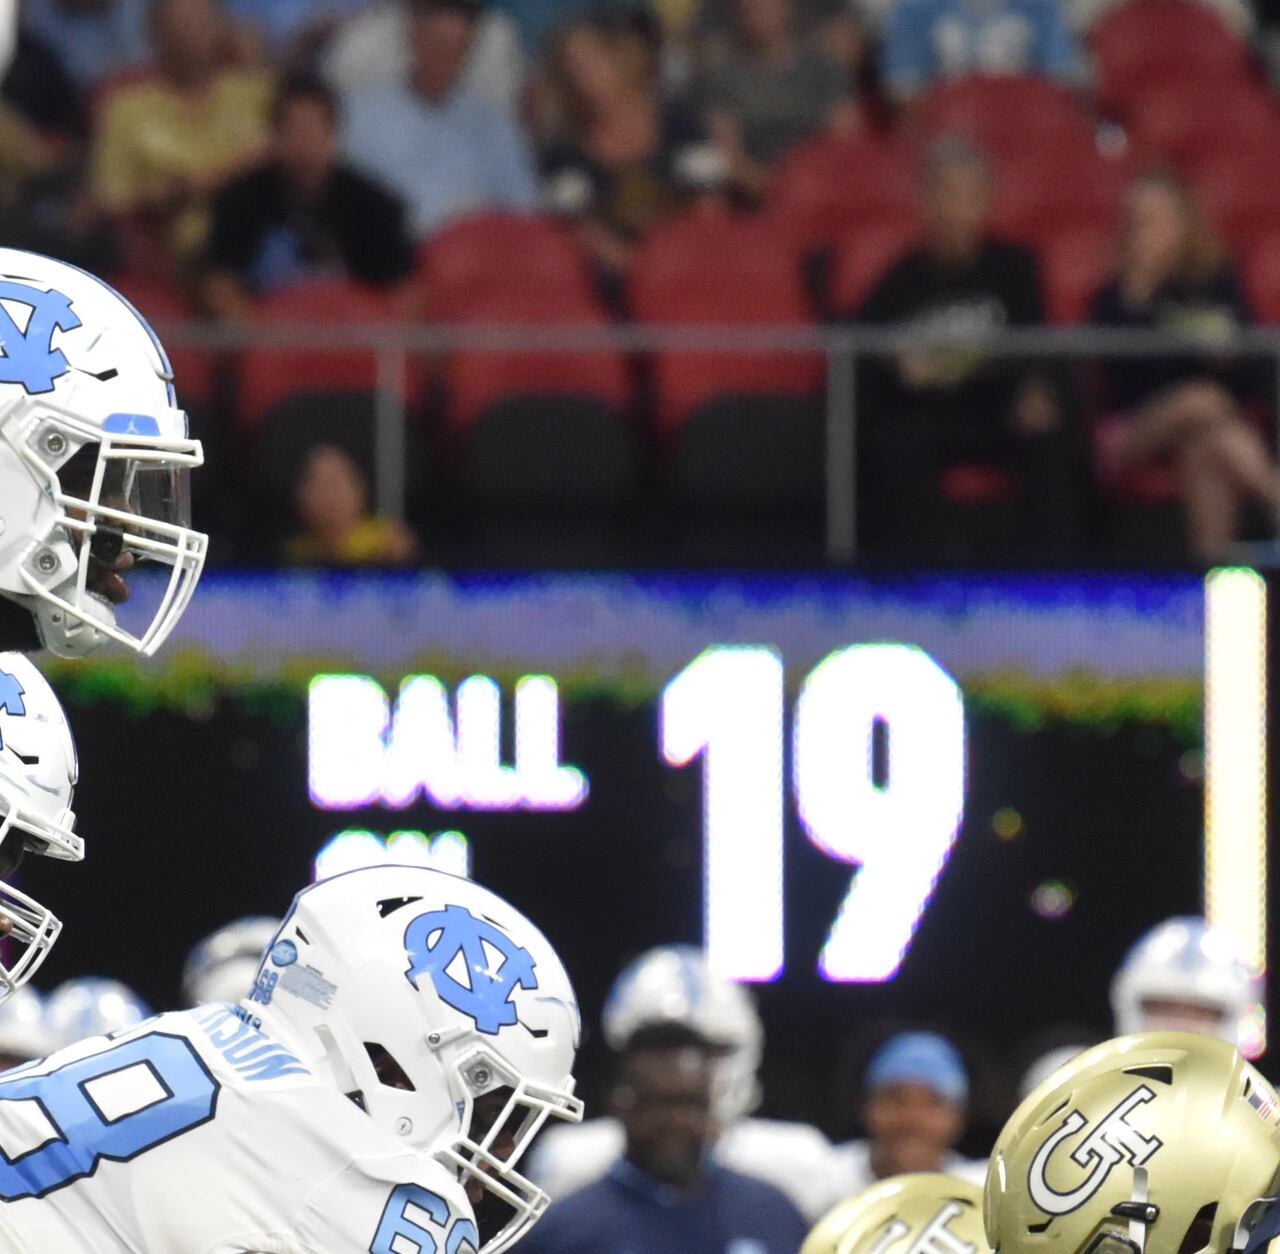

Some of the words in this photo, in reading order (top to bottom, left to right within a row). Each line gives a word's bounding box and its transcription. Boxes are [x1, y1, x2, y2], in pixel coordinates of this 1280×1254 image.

[308, 674, 589, 811] BALL
[660, 643, 968, 983] 19
[1026, 1084, 1164, 1217] GT
